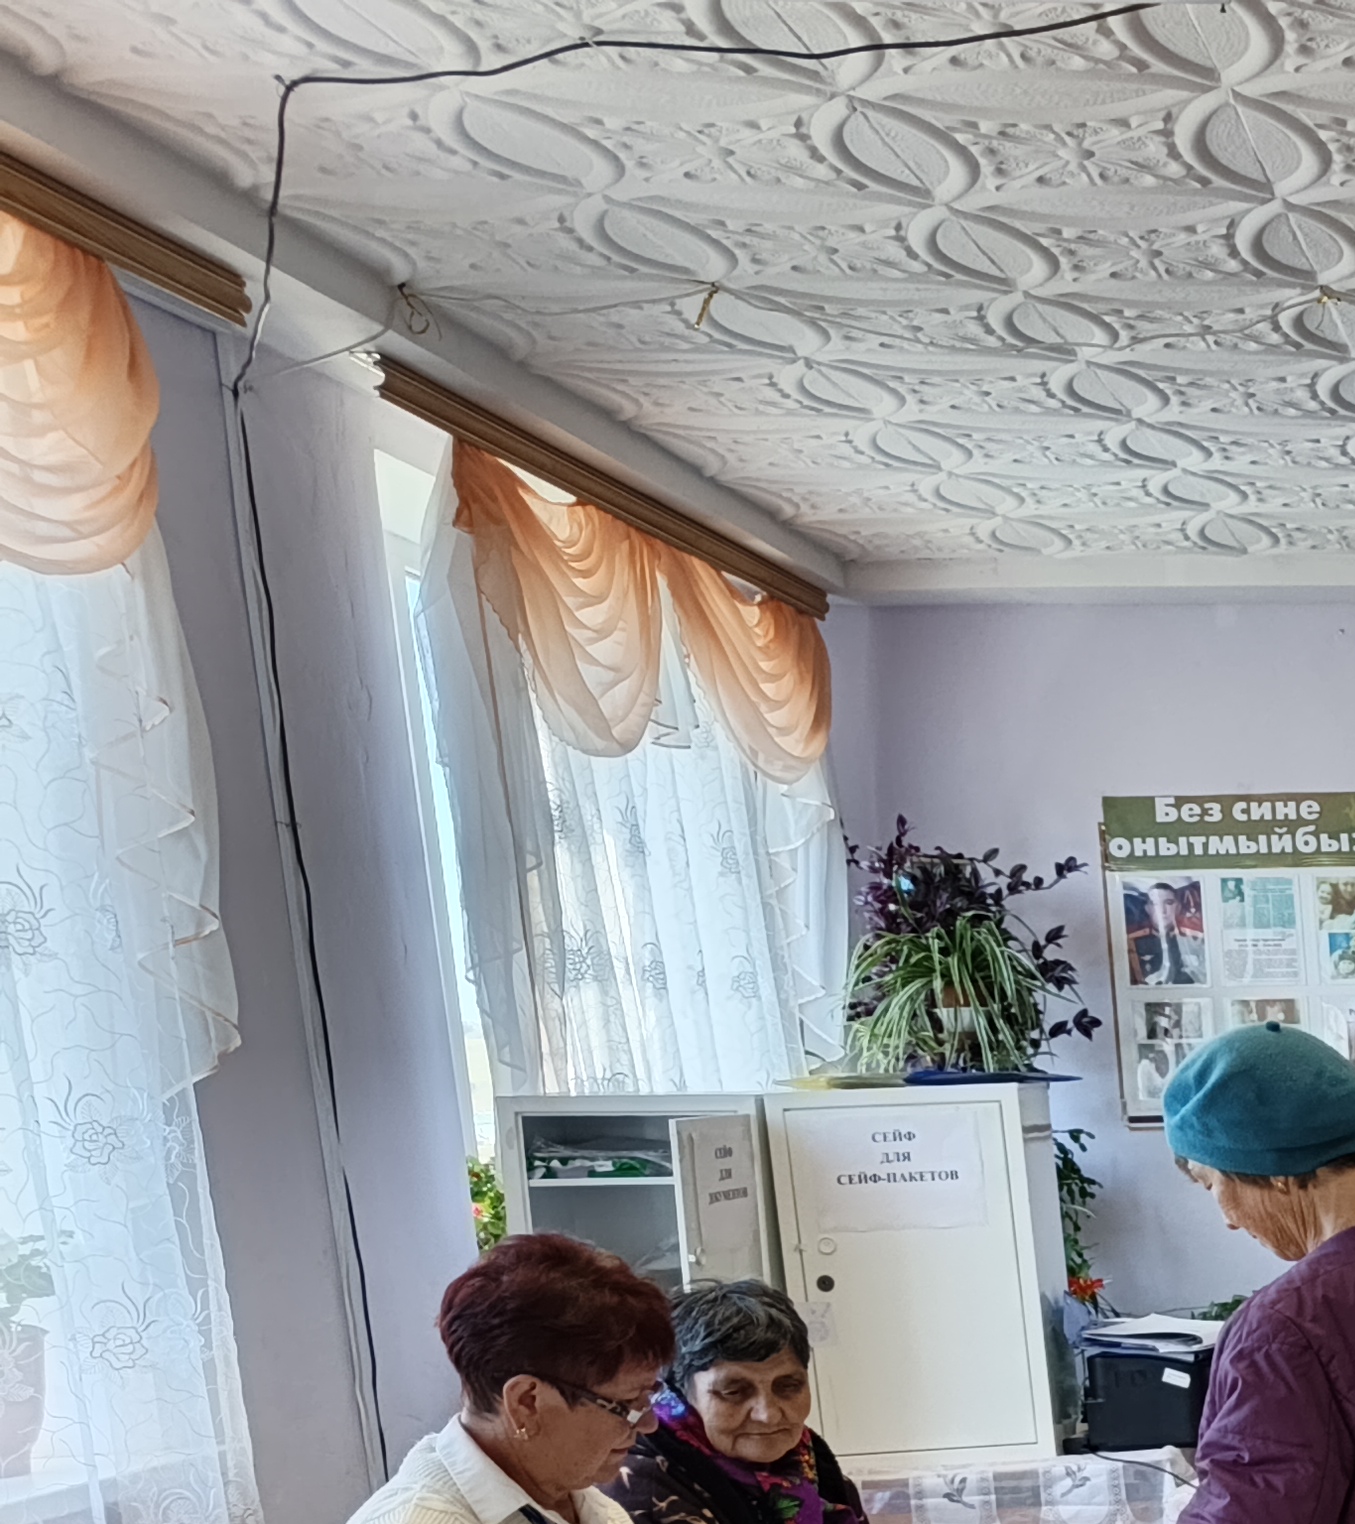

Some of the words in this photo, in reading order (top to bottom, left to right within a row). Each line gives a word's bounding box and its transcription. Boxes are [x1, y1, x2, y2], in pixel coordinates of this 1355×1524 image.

[1154, 797, 1223, 823] Без
[1232, 800, 1321, 822] сине
[871, 1129, 916, 1143] СЕЙФ
[880, 1151, 911, 1164] ДЛЯ
[836, 1169, 959, 1185] СЕЙФ-ПАКЕТОВ
